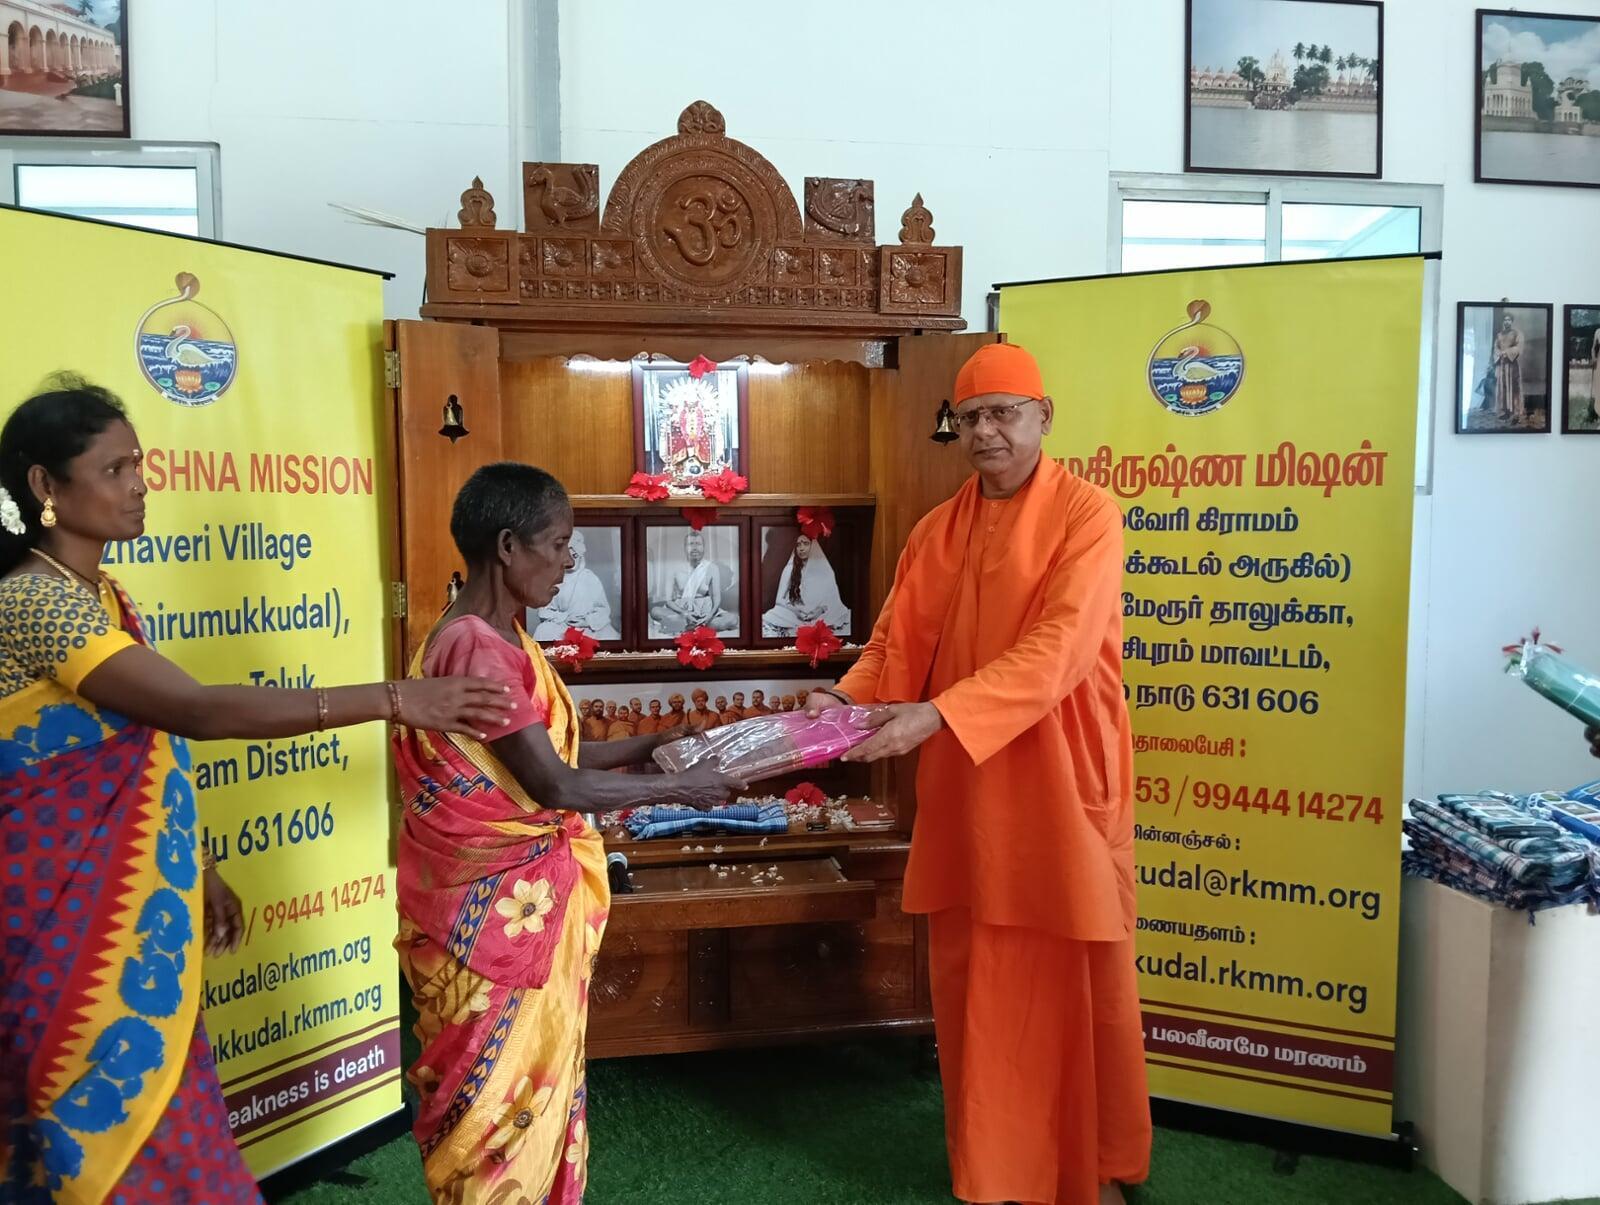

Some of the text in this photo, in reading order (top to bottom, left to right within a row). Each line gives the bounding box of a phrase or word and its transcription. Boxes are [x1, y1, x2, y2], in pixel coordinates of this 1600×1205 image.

[145, 447, 373, 496] SHNA MISSION
[1255, 438, 1388, 498] மிஷன்
[1123, 505, 1299, 536] வேரி கிராமம்
[218, 522, 312, 571] Village
[1124, 549, 1352, 584] க்கூடல் அருகில்)
[1121, 591, 1353, 632] மேரூர் தாலுக்கா,
[1122, 635, 1330, 673] சிபுரம் மாவட்டம்,
[1136, 684, 1195, 712] நாடு
[193, 733, 349, 791] am District,
[237, 802, 335, 857] 631606
[263, 889, 325, 933] 99444
[331, 873, 386, 913] 14274
[1134, 861, 1381, 921] udal@rkmm.org
[1136, 917, 1245, 944] ணையதளம்
[1135, 952, 1368, 1014] kudal.rkmm.org
[1152, 1027, 1367, 1074] பலவீனமே மரணம்
[228, 1044, 385, 1130] eakness is death
